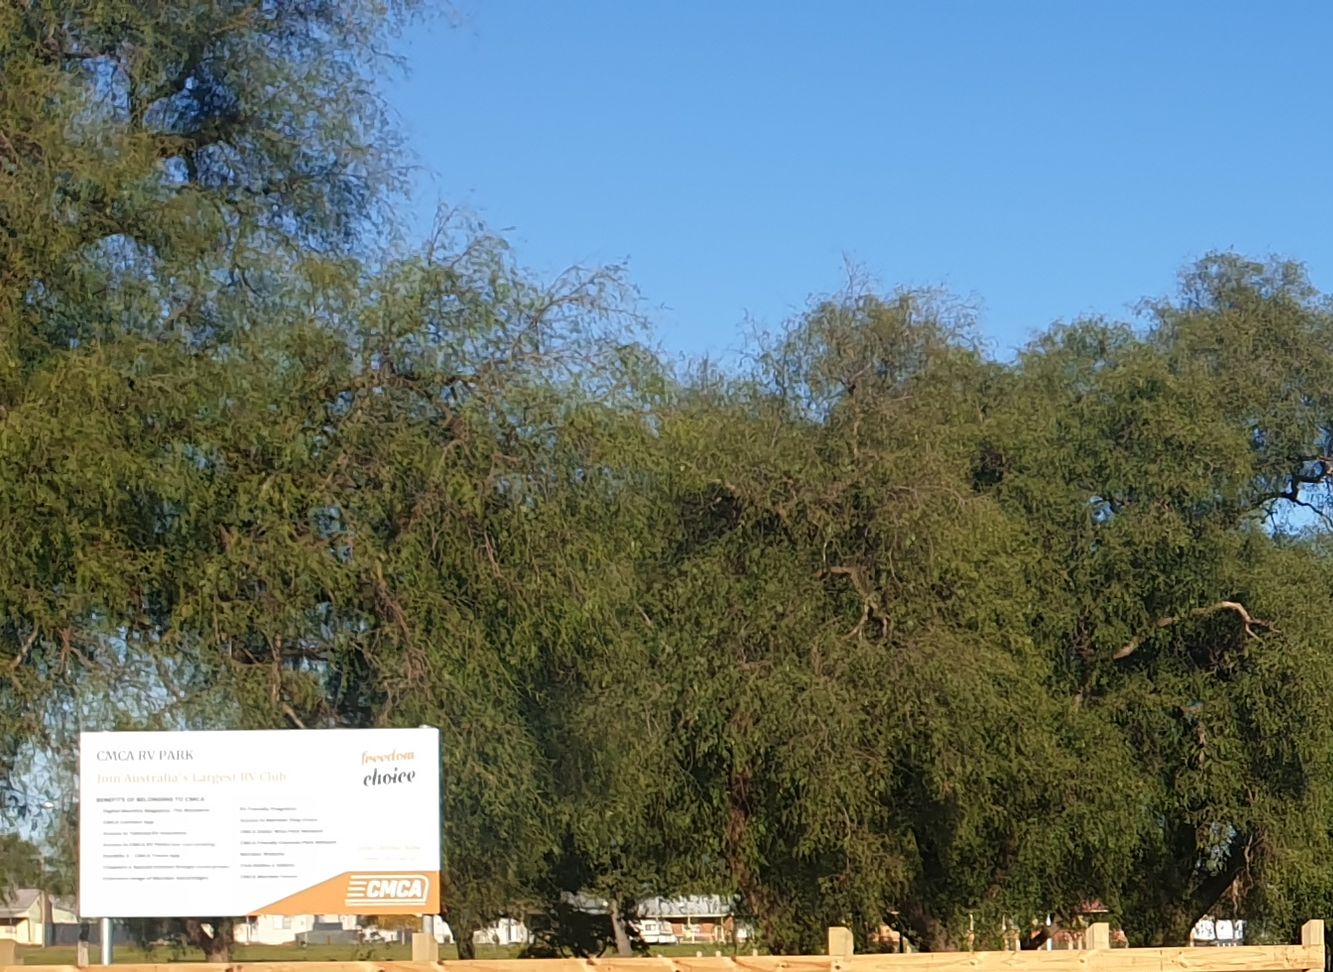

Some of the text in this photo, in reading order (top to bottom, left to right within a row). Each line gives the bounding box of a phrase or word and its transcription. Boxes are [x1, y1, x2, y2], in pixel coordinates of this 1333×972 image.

[96, 749, 194, 761] CMCA RV PARK
[363, 767, 416, 787] choice
[366, 879, 423, 899] CMCA
